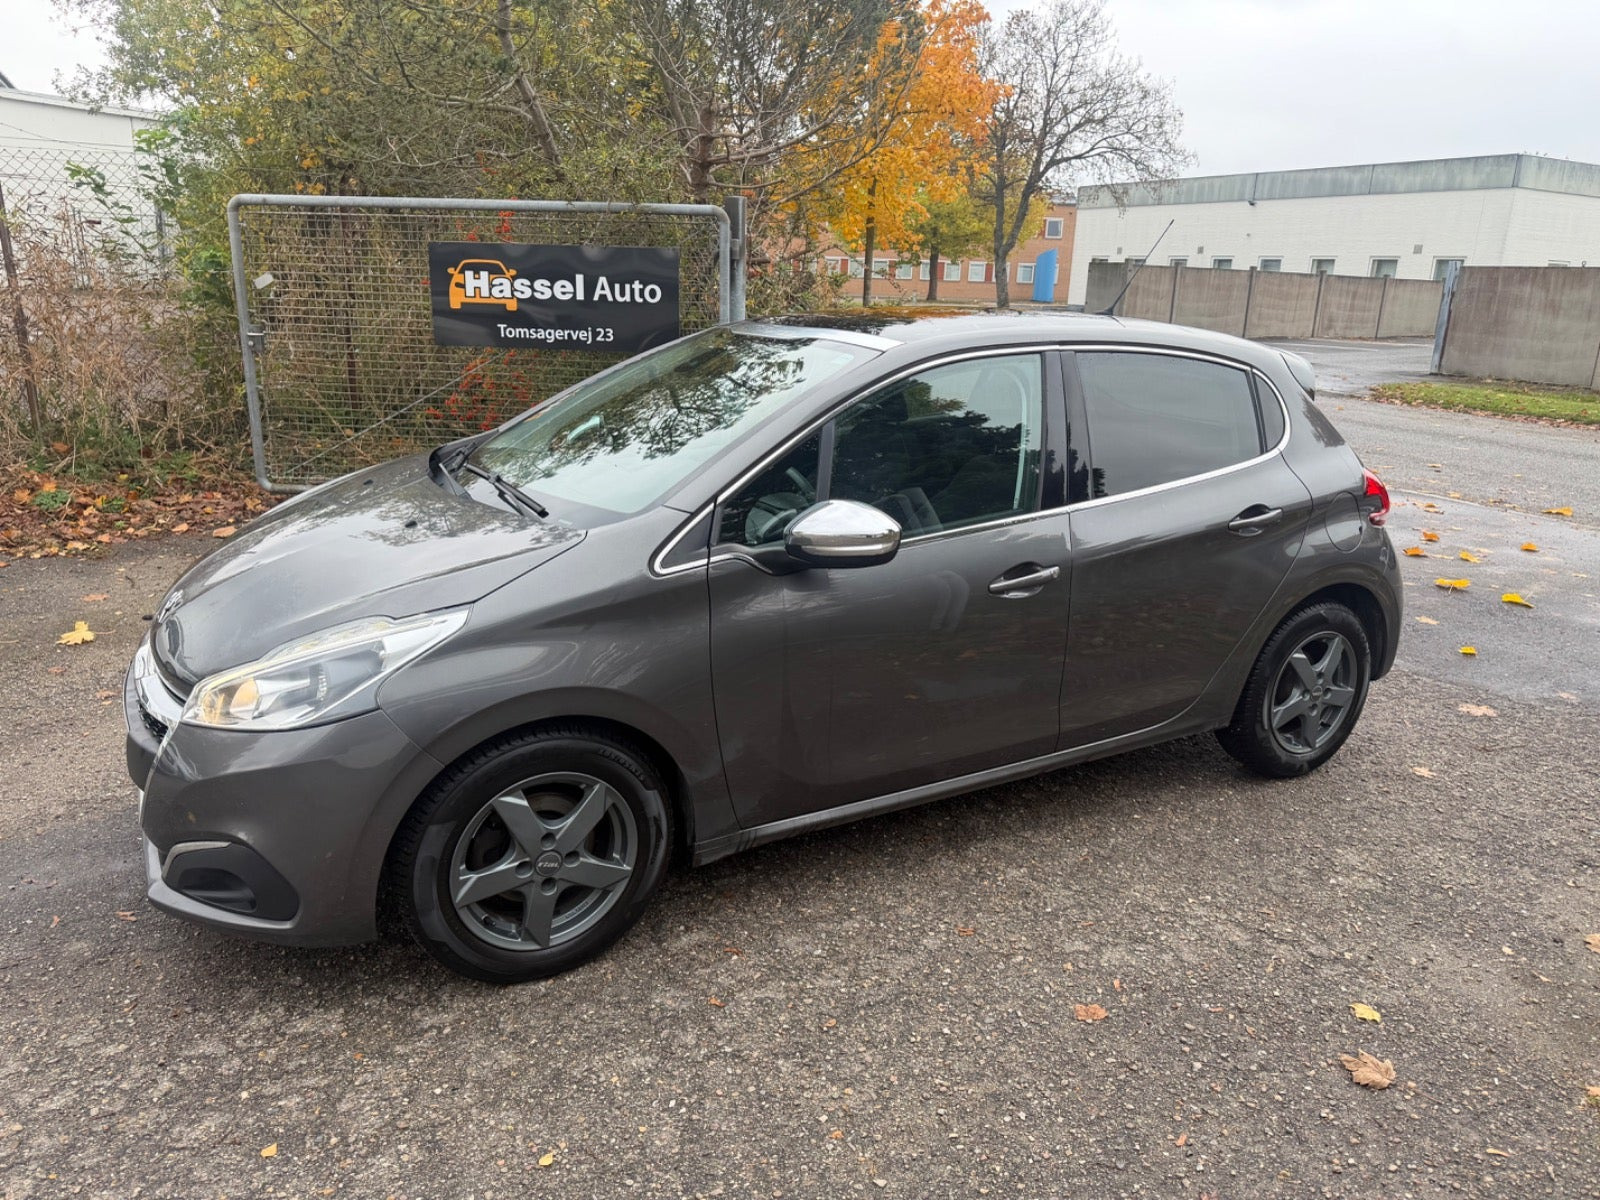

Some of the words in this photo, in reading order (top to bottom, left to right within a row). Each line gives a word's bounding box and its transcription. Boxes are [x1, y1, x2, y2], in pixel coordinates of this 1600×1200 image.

[464, 270, 585, 301] Hassel
[593, 275, 662, 304] Auto
[497, 323, 593, 344] Tomsagervej
[596, 327, 614, 342] 23
